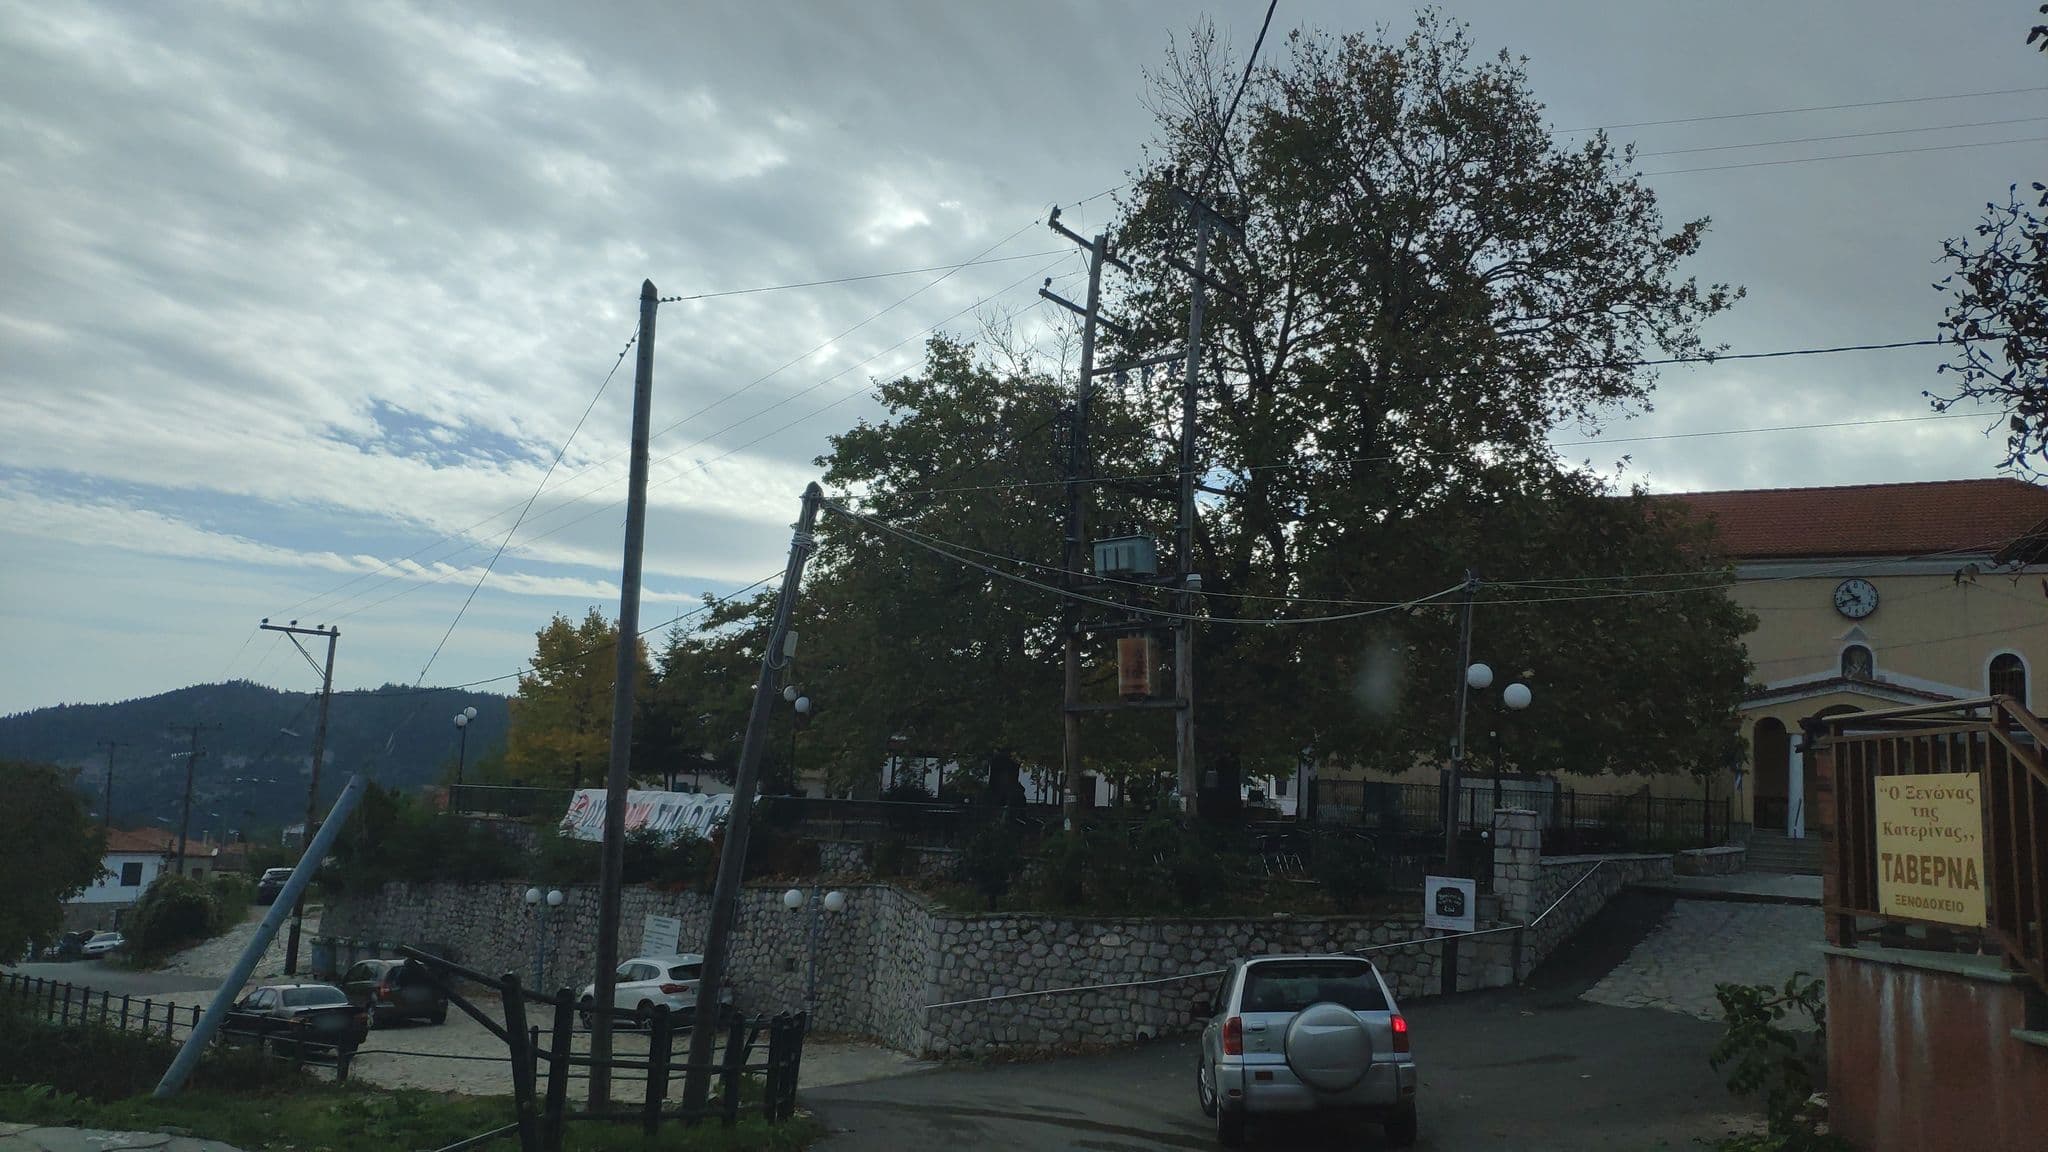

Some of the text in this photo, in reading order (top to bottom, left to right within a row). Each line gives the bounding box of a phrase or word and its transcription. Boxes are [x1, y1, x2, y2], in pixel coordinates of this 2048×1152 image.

[1905, 785, 1975, 805] Ξενώνας
[1911, 806, 1939, 822] της
[1881, 852, 1980, 891] ΤΑΒΕΡΝΑ
[1895, 894, 1965, 913] ΞΕΝΟΔΟΧΕΙΟ
